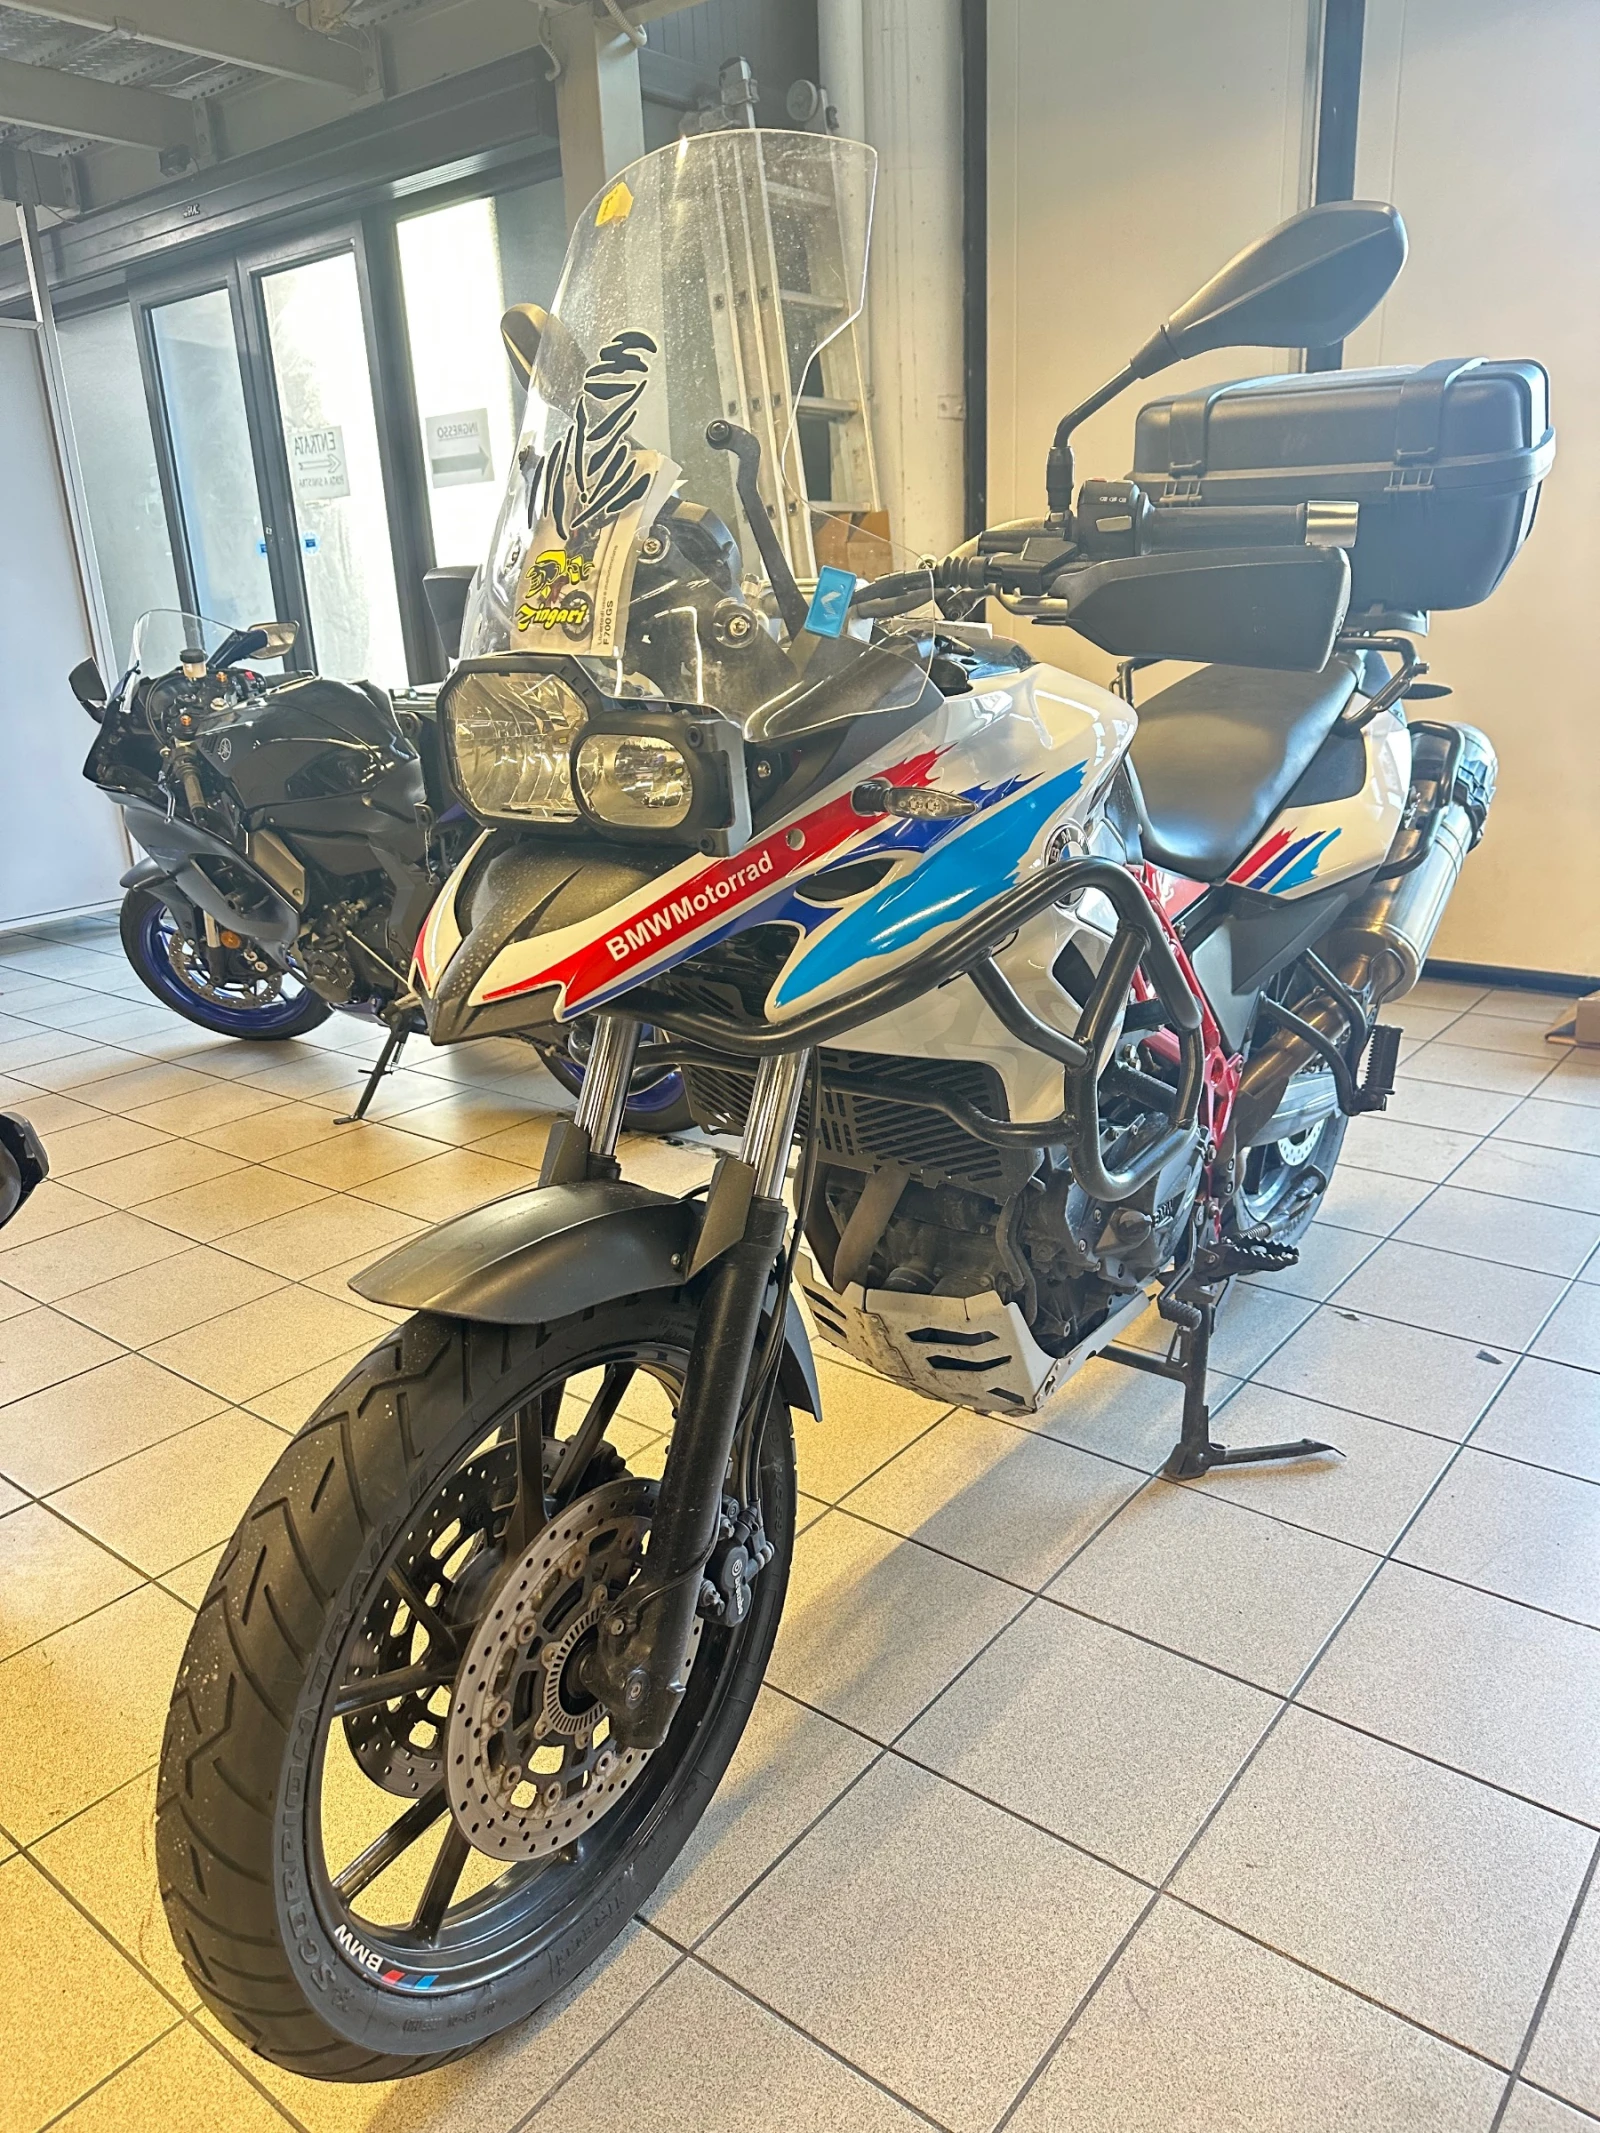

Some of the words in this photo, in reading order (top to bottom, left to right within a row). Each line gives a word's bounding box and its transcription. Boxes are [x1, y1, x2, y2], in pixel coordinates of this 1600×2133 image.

[515, 602, 588, 632] Zingari
[606, 600, 613, 616] GS
[307, 1514, 401, 1695] TRAIL
[733, 1575, 744, 1615] brembo
[282, 1706, 338, 1992] SCORPION
[333, 1923, 384, 1973] BMW
